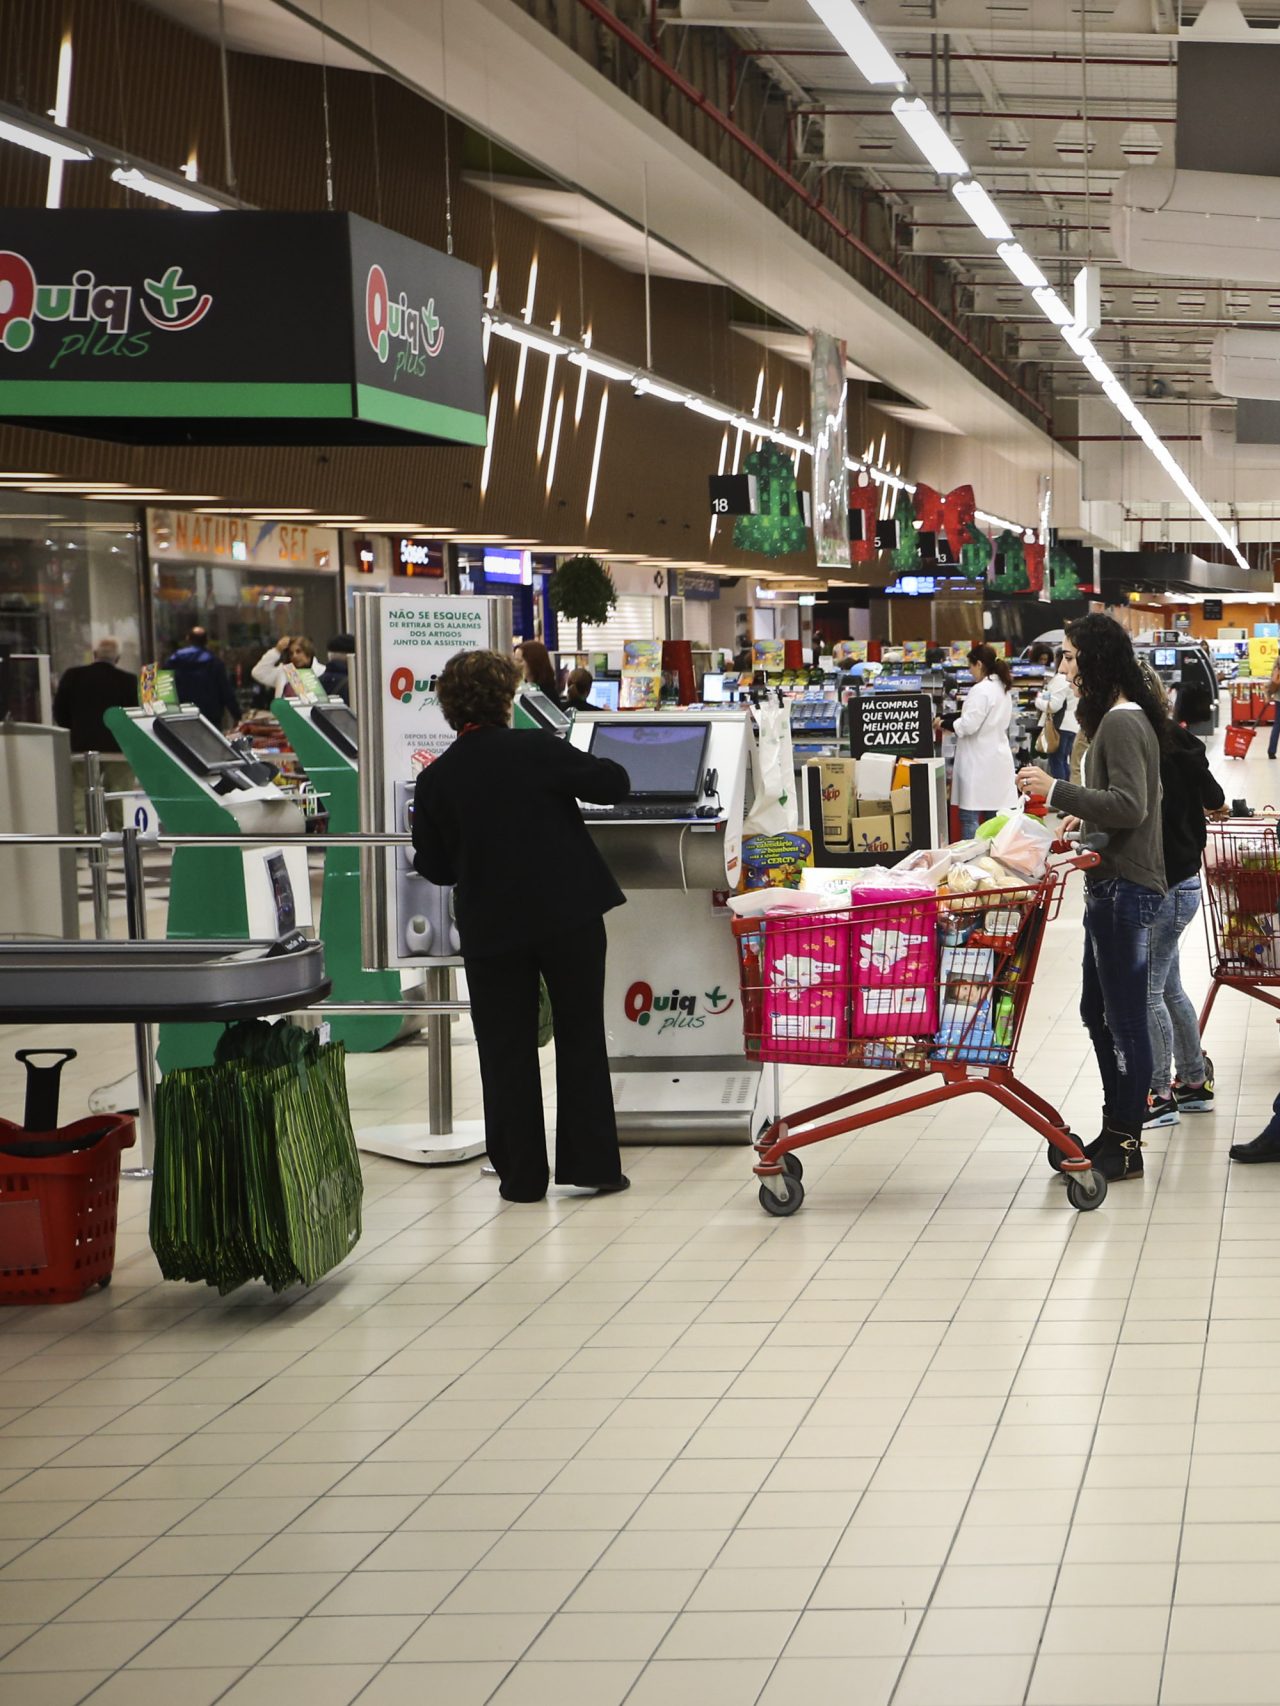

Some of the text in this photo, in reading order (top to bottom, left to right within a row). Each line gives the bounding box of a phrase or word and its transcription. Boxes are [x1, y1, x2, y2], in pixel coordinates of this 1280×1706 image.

[366, 264, 419, 363] Quiq
[50, 318, 152, 369] plus
[393, 338, 426, 382] plus
[712, 499, 728, 512] 18
[279, 526, 309, 561] SET
[874, 537, 881, 547] 5
[389, 609, 482, 622] NÃO SE ESQUEÇA
[862, 700, 918, 710] HÁ COMPRAS
[862, 711, 919, 722] QUE VIAJAM
[863, 721, 919, 732] MELHOR EM
[863, 731, 920, 746] CAIXAS
[625, 981, 697, 1026] Quiq
[658, 1011, 706, 1035] plus
